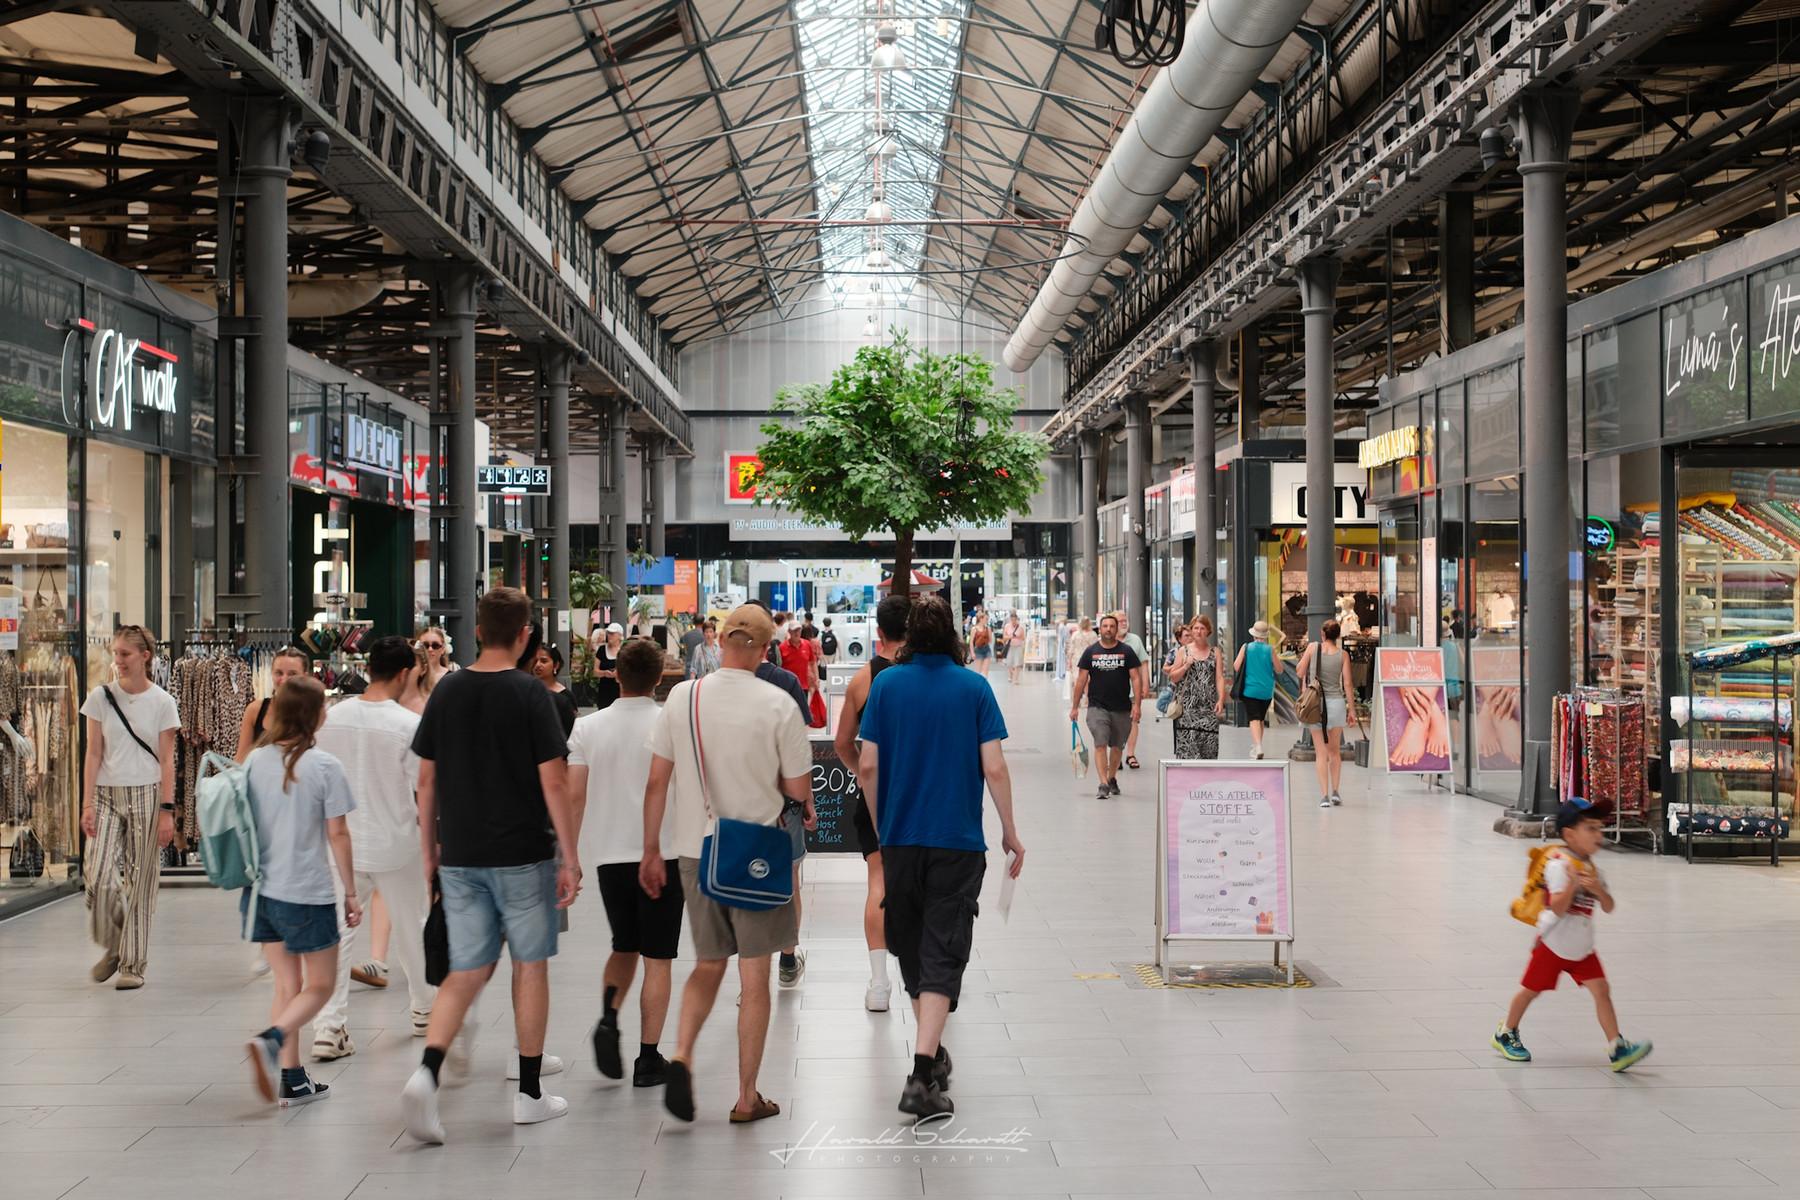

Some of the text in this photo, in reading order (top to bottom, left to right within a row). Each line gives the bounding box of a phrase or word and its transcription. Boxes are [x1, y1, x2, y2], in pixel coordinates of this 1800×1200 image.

[1666, 305, 1743, 396] Luma's
[141, 362, 178, 414] walk
[350, 414, 403, 470] DEPOT
[1297, 486, 1367, 518] CTY
[811, 567, 842, 578] WELT
[1091, 659, 1125, 668] PASCALE
[1199, 804, 1256, 815] STOFFE
[818, 830, 842, 843] Bluse
